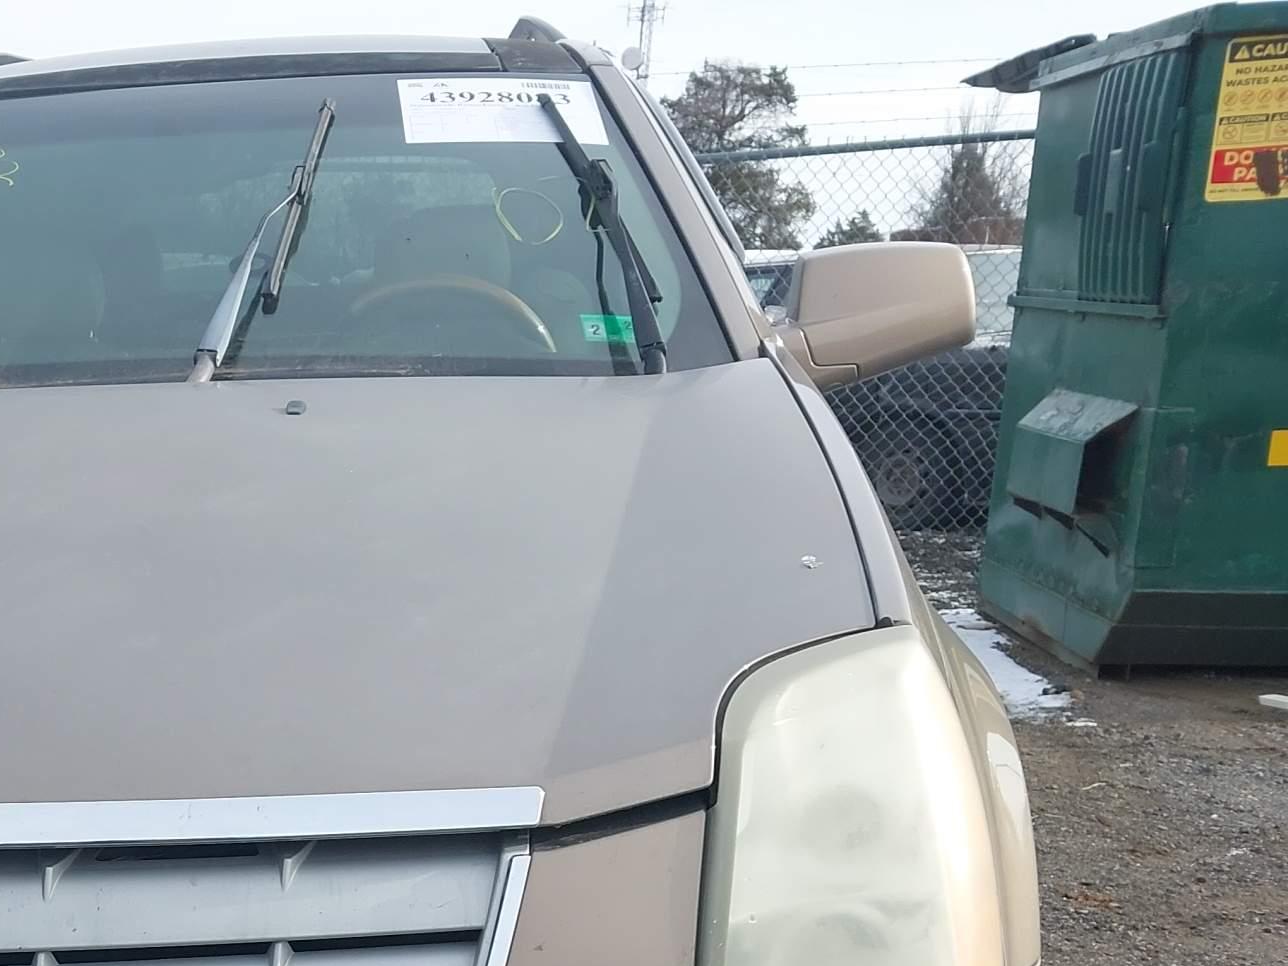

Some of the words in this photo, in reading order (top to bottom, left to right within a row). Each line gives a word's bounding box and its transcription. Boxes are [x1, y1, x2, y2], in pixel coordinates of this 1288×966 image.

[1235, 67, 1251, 75] NO
[1226, 77, 1269, 87] WASTES
[420, 91, 572, 105] 4392803
[1224, 150, 1254, 166] DO
[1233, 166, 1257, 182] PA
[591, 324, 601, 336] 2
